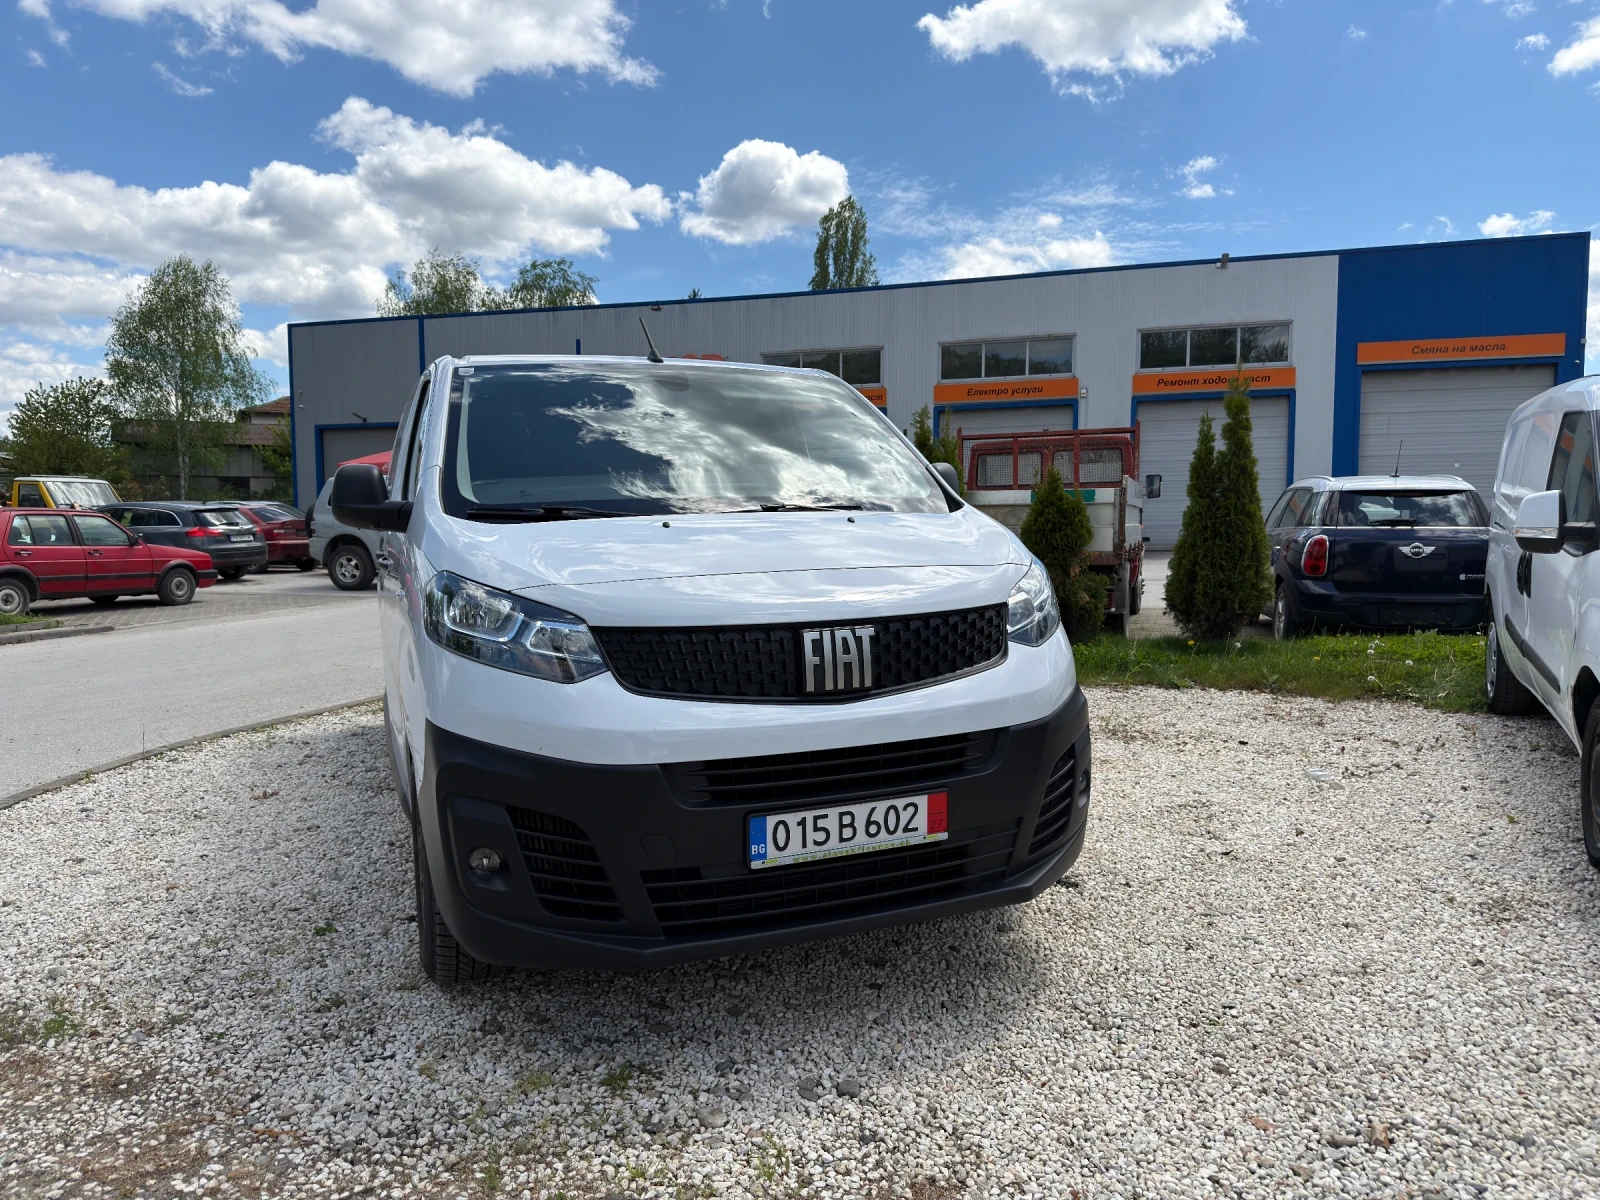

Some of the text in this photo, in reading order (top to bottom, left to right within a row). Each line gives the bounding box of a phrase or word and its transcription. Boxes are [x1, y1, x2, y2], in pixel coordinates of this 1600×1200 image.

[1411, 343, 1506, 355] Смяна на масла
[1157, 377, 1199, 387] Ремонт
[967, 386, 1044, 397] Електро услуги
[802, 625, 875, 692] FIAT
[752, 844, 766, 855] BG
